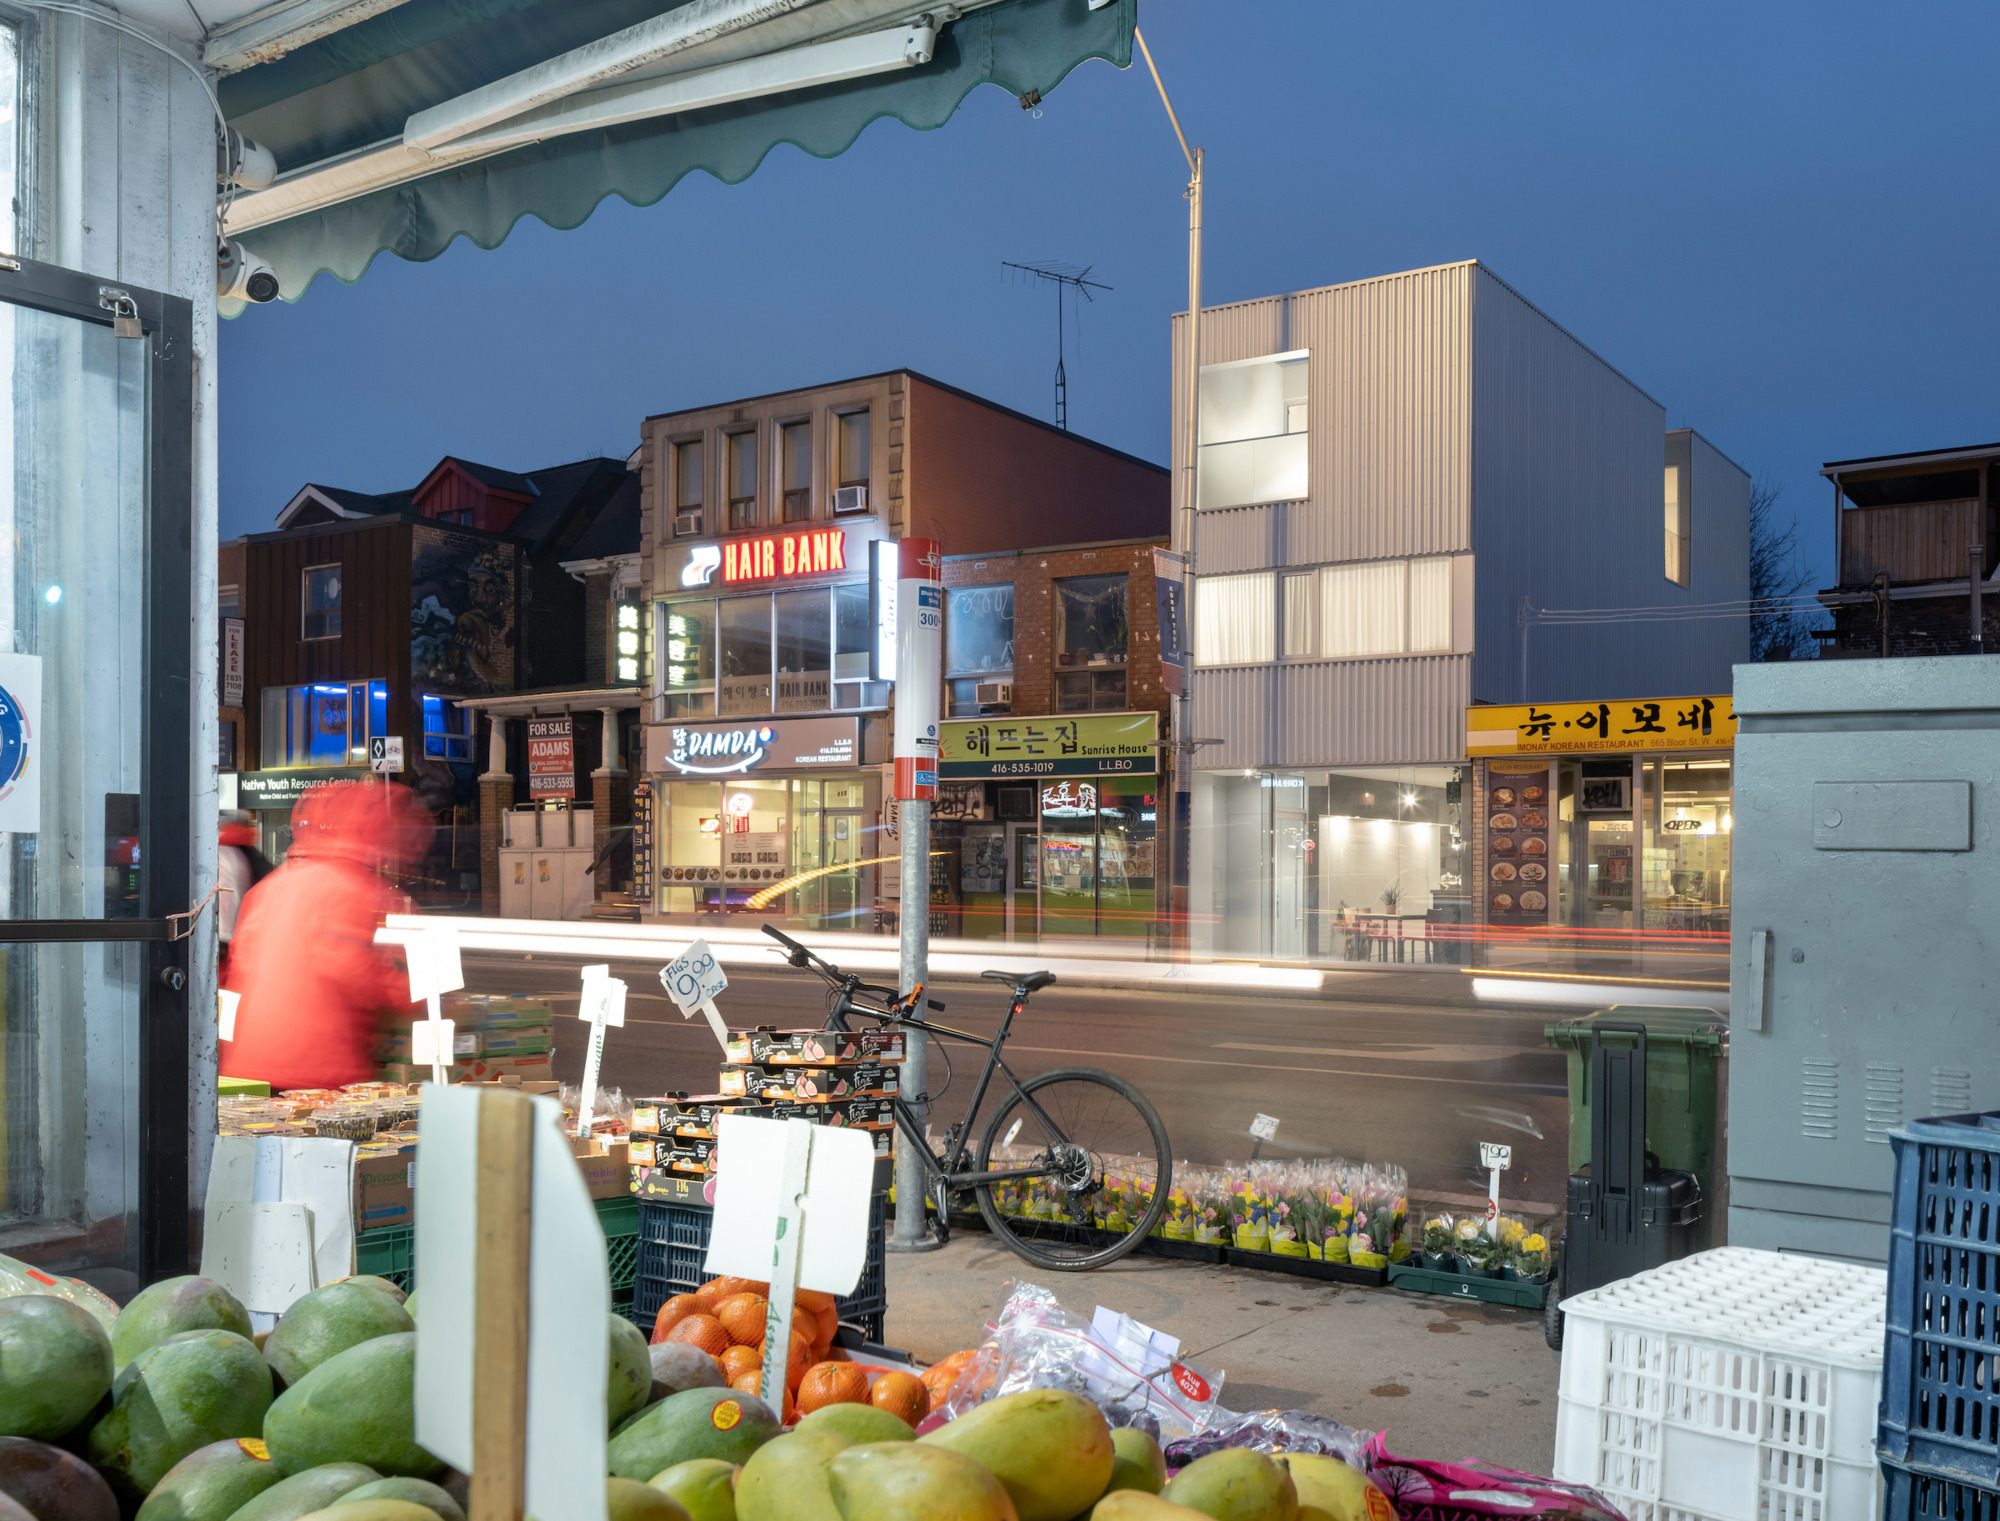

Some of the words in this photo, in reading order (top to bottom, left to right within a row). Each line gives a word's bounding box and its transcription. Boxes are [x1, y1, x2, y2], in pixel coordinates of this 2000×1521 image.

[724, 539, 775, 581] HAIR
[782, 531, 845, 575] BANK
[921, 613, 941, 627] 300
[230, 634, 239, 672] LEASE
[780, 682, 800, 697] HAIR
[804, 681, 827, 696] BANK
[530, 724, 547, 736] FOR
[549, 722, 571, 735] SALE
[689, 729, 759, 757] DAMDA
[966, 721, 1078, 757] 해뜨는집
[1551, 741, 1586, 751] KOREAN
[1588, 739, 1644, 749] RESTAURANT
[1651, 738, 1665, 747] 665
[1667, 738, 1686, 747] Bloor
[1701, 737, 1710, 745] W
[532, 741, 570, 757] ADAMS
[1082, 745, 1116, 756] Sunrise
[1119, 744, 1148, 755] House
[796, 756, 817, 764] KOREAN
[818, 754, 852, 763] RESTAURANT
[992, 763, 1054, 774] 416-535-1019
[242, 778, 266, 791] Native
[267, 778, 289, 790] Youth
[291, 777, 327, 790] Resource
[329, 777, 357, 789] Centre
[531, 777, 574, 790] 416-533-5593
[1103, 814, 1136, 828] OPEN
[1668, 820, 1698, 830] OPEN
[1610, 849, 1628, 857] CLOSED
[666, 957, 689, 979] FIGS
[706, 980, 728, 998] CASE
[752, 1039, 773, 1060] Figs
[861, 1036, 880, 1056] Figs
[746, 1072, 767, 1093] Figs
[853, 1071, 873, 1092] Figs
[659, 1108, 680, 1131] Figs
[848, 1103, 868, 1124] Figs
[656, 1143, 677, 1166] Figs
[676, 1180, 689, 1192] FIG
[1180, 1379, 1198, 1396] 4023
